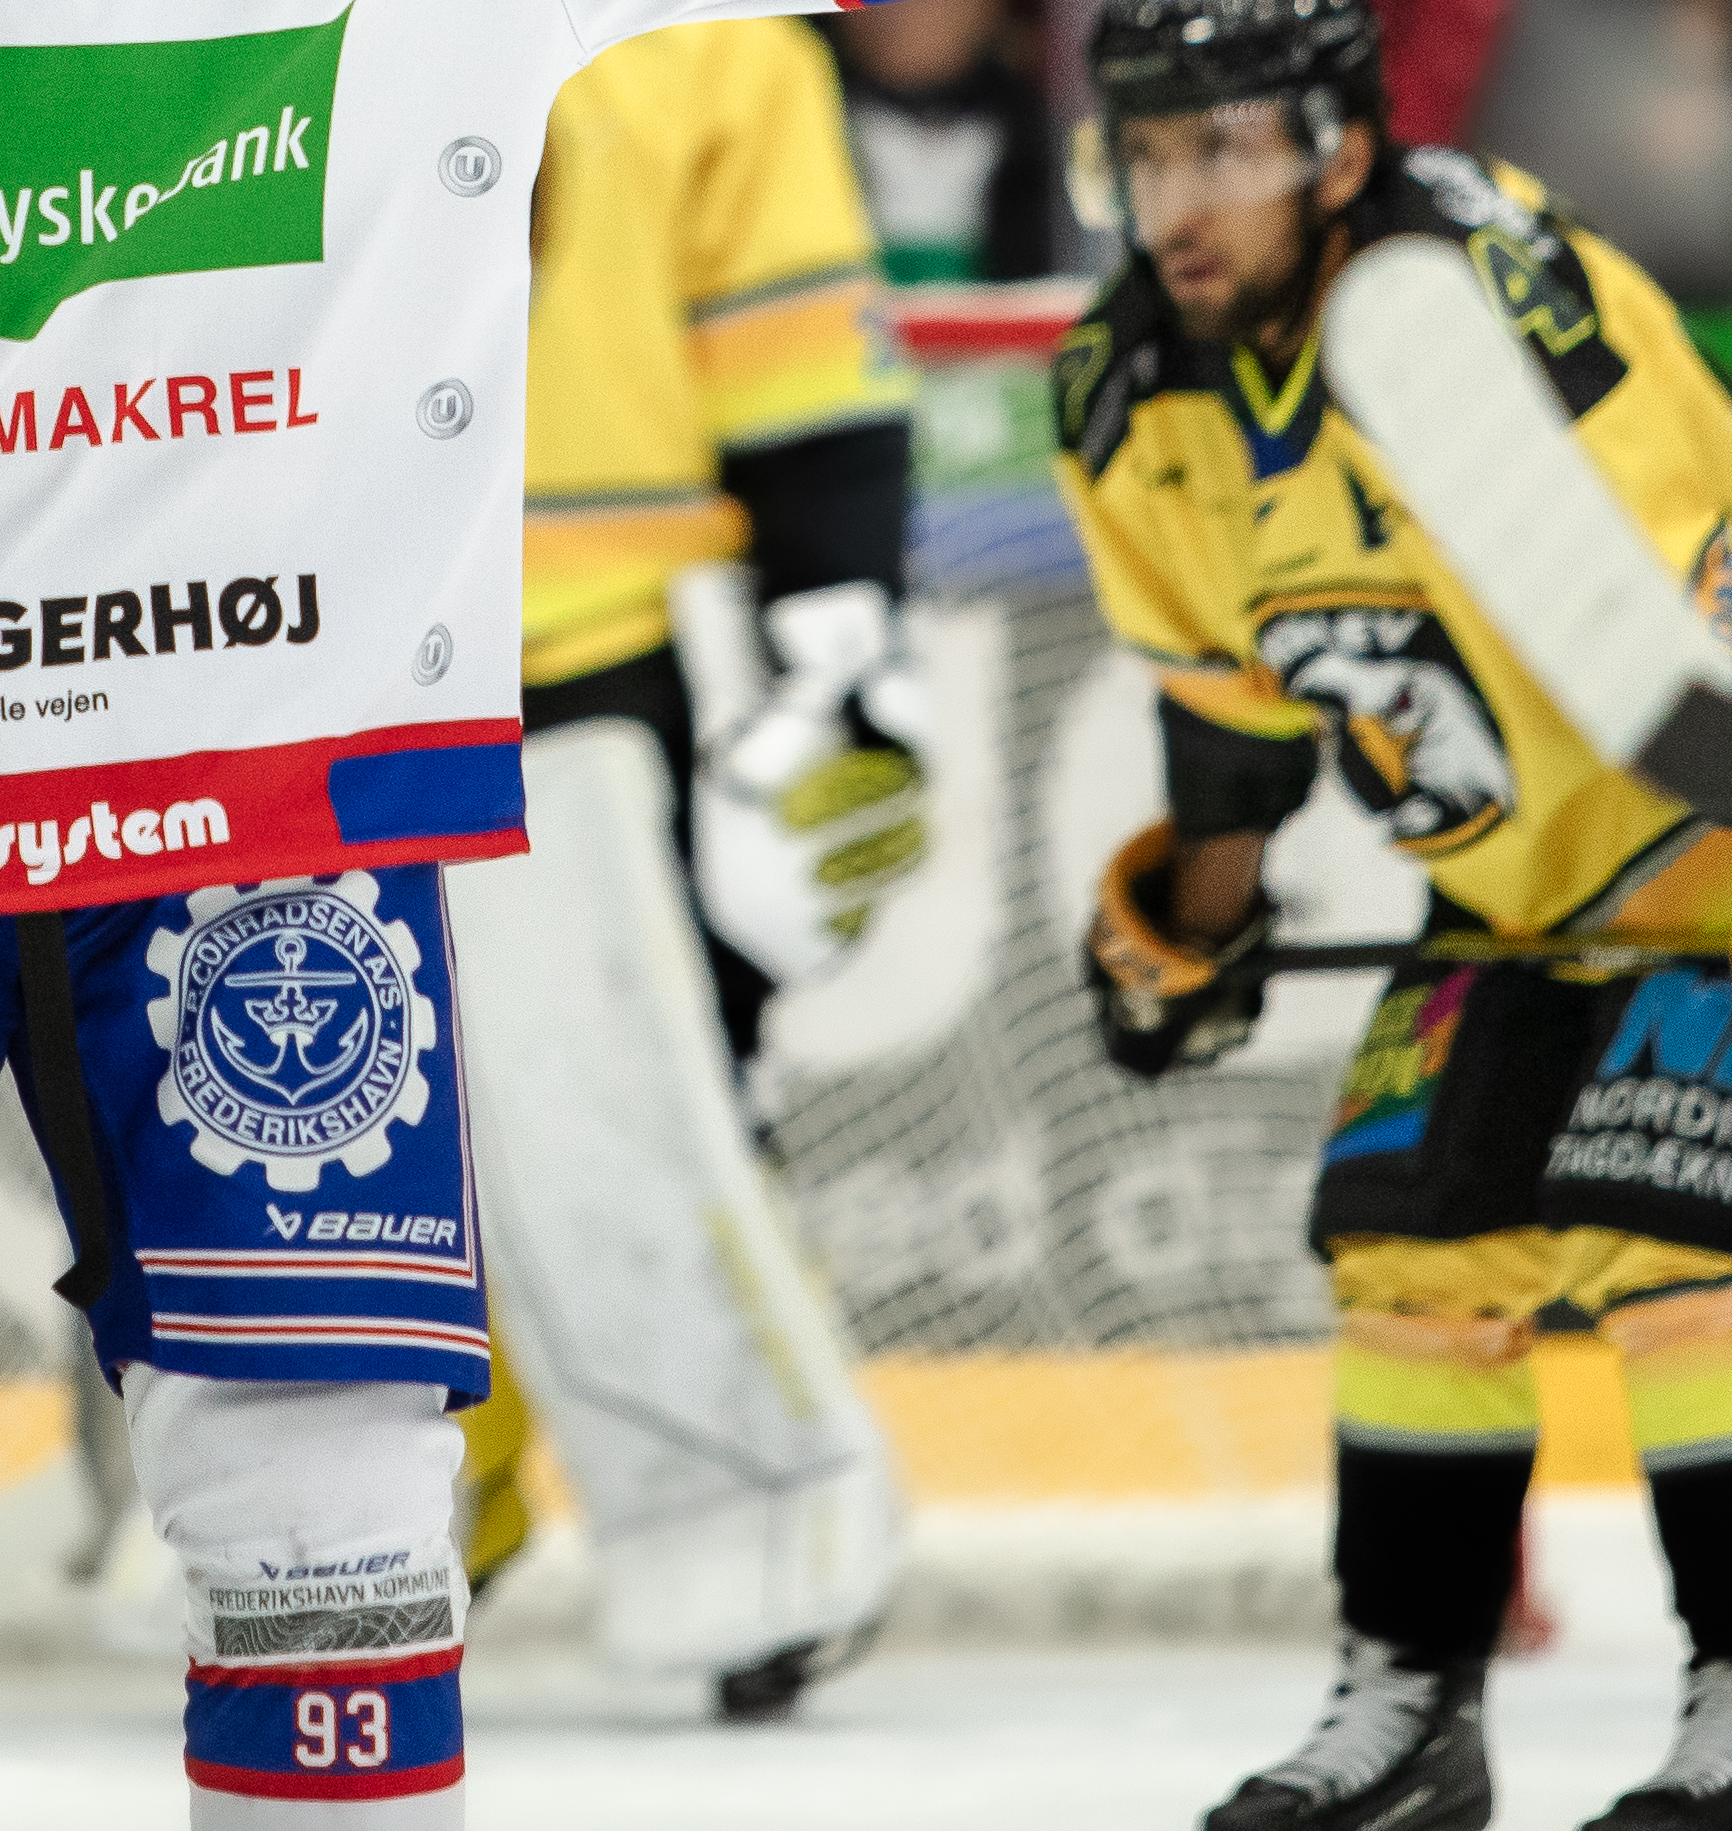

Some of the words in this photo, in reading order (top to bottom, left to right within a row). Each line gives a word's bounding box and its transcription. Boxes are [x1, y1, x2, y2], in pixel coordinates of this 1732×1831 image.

[158, 105, 313, 201] ank
[34, 689, 110, 723] vejen
[179, 1038, 403, 1146] FREDERIKSHAVN
[308, 1211, 457, 1248] BAUER
[209, 1582, 365, 1612] FREDERIKSHAVN
[295, 1690, 390, 1768] 93
